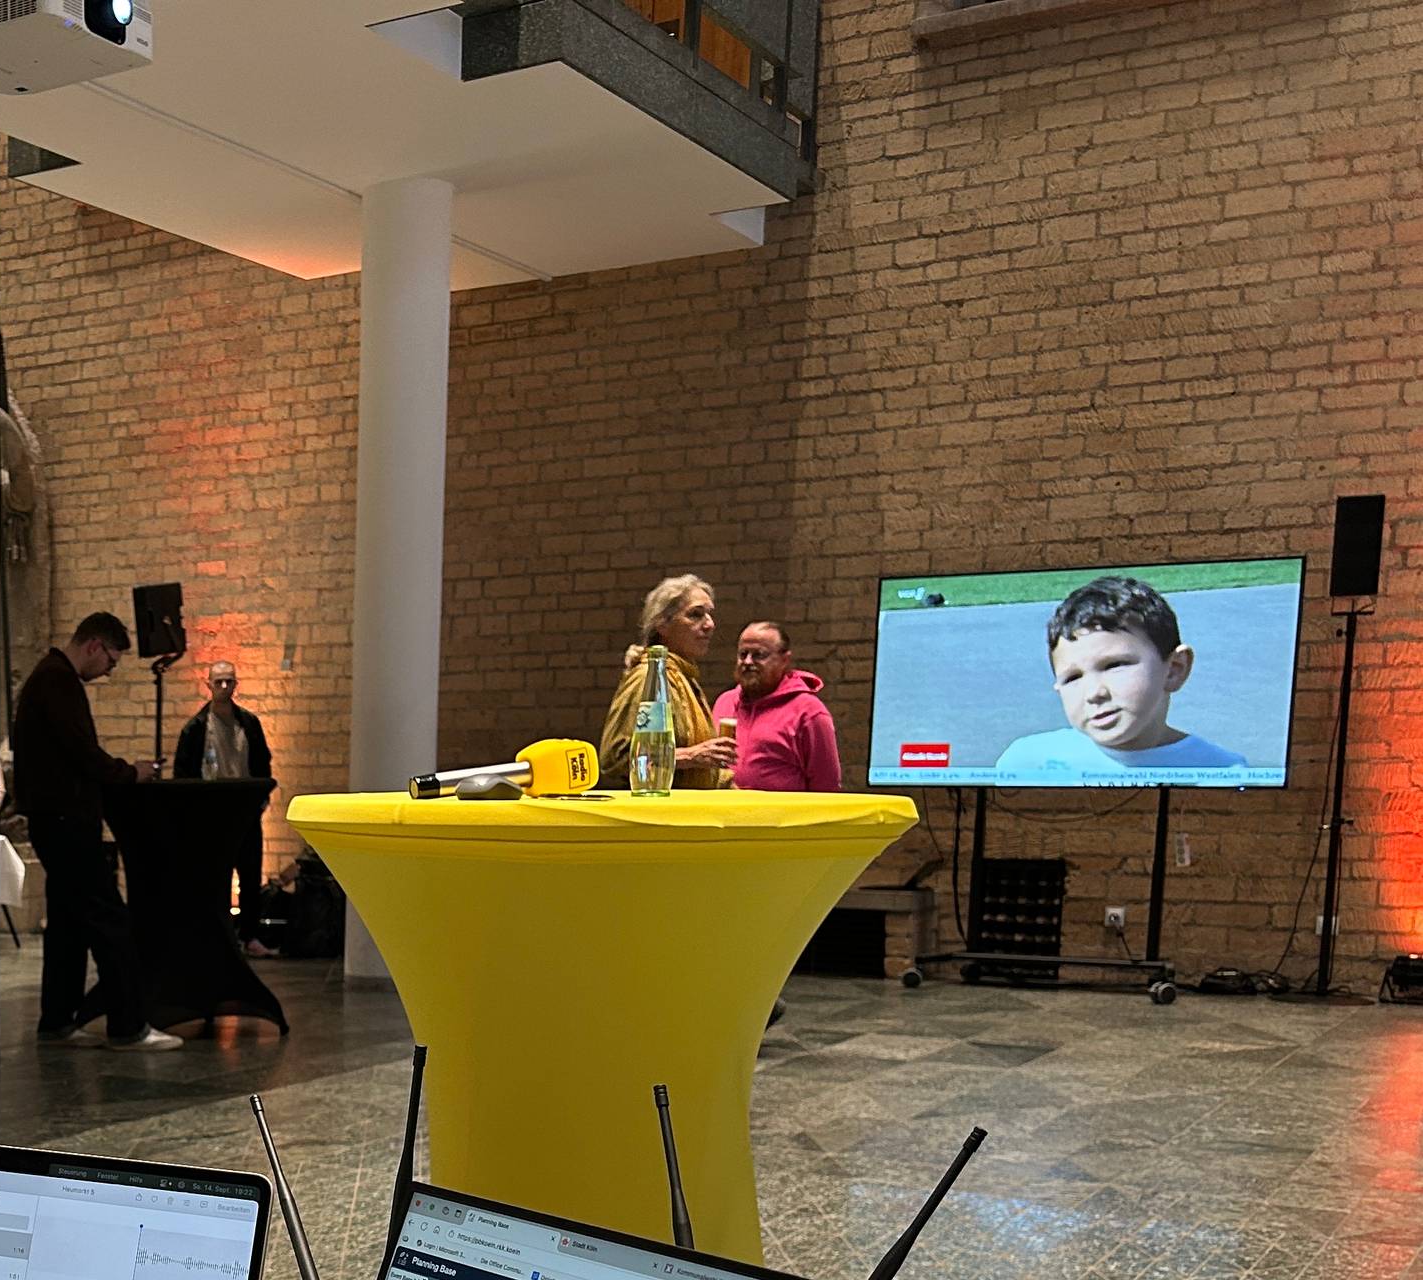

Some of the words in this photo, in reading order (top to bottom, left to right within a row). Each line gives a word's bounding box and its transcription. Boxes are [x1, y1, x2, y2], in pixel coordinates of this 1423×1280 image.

[571, 757, 579, 780] Köln
[578, 753, 587, 781] Radio
[477, 1216, 497, 1228] Planning
[572, 1240, 586, 1249] Stadt
[411, 1256, 440, 1272] Planning
[440, 1263, 457, 1277] Base
